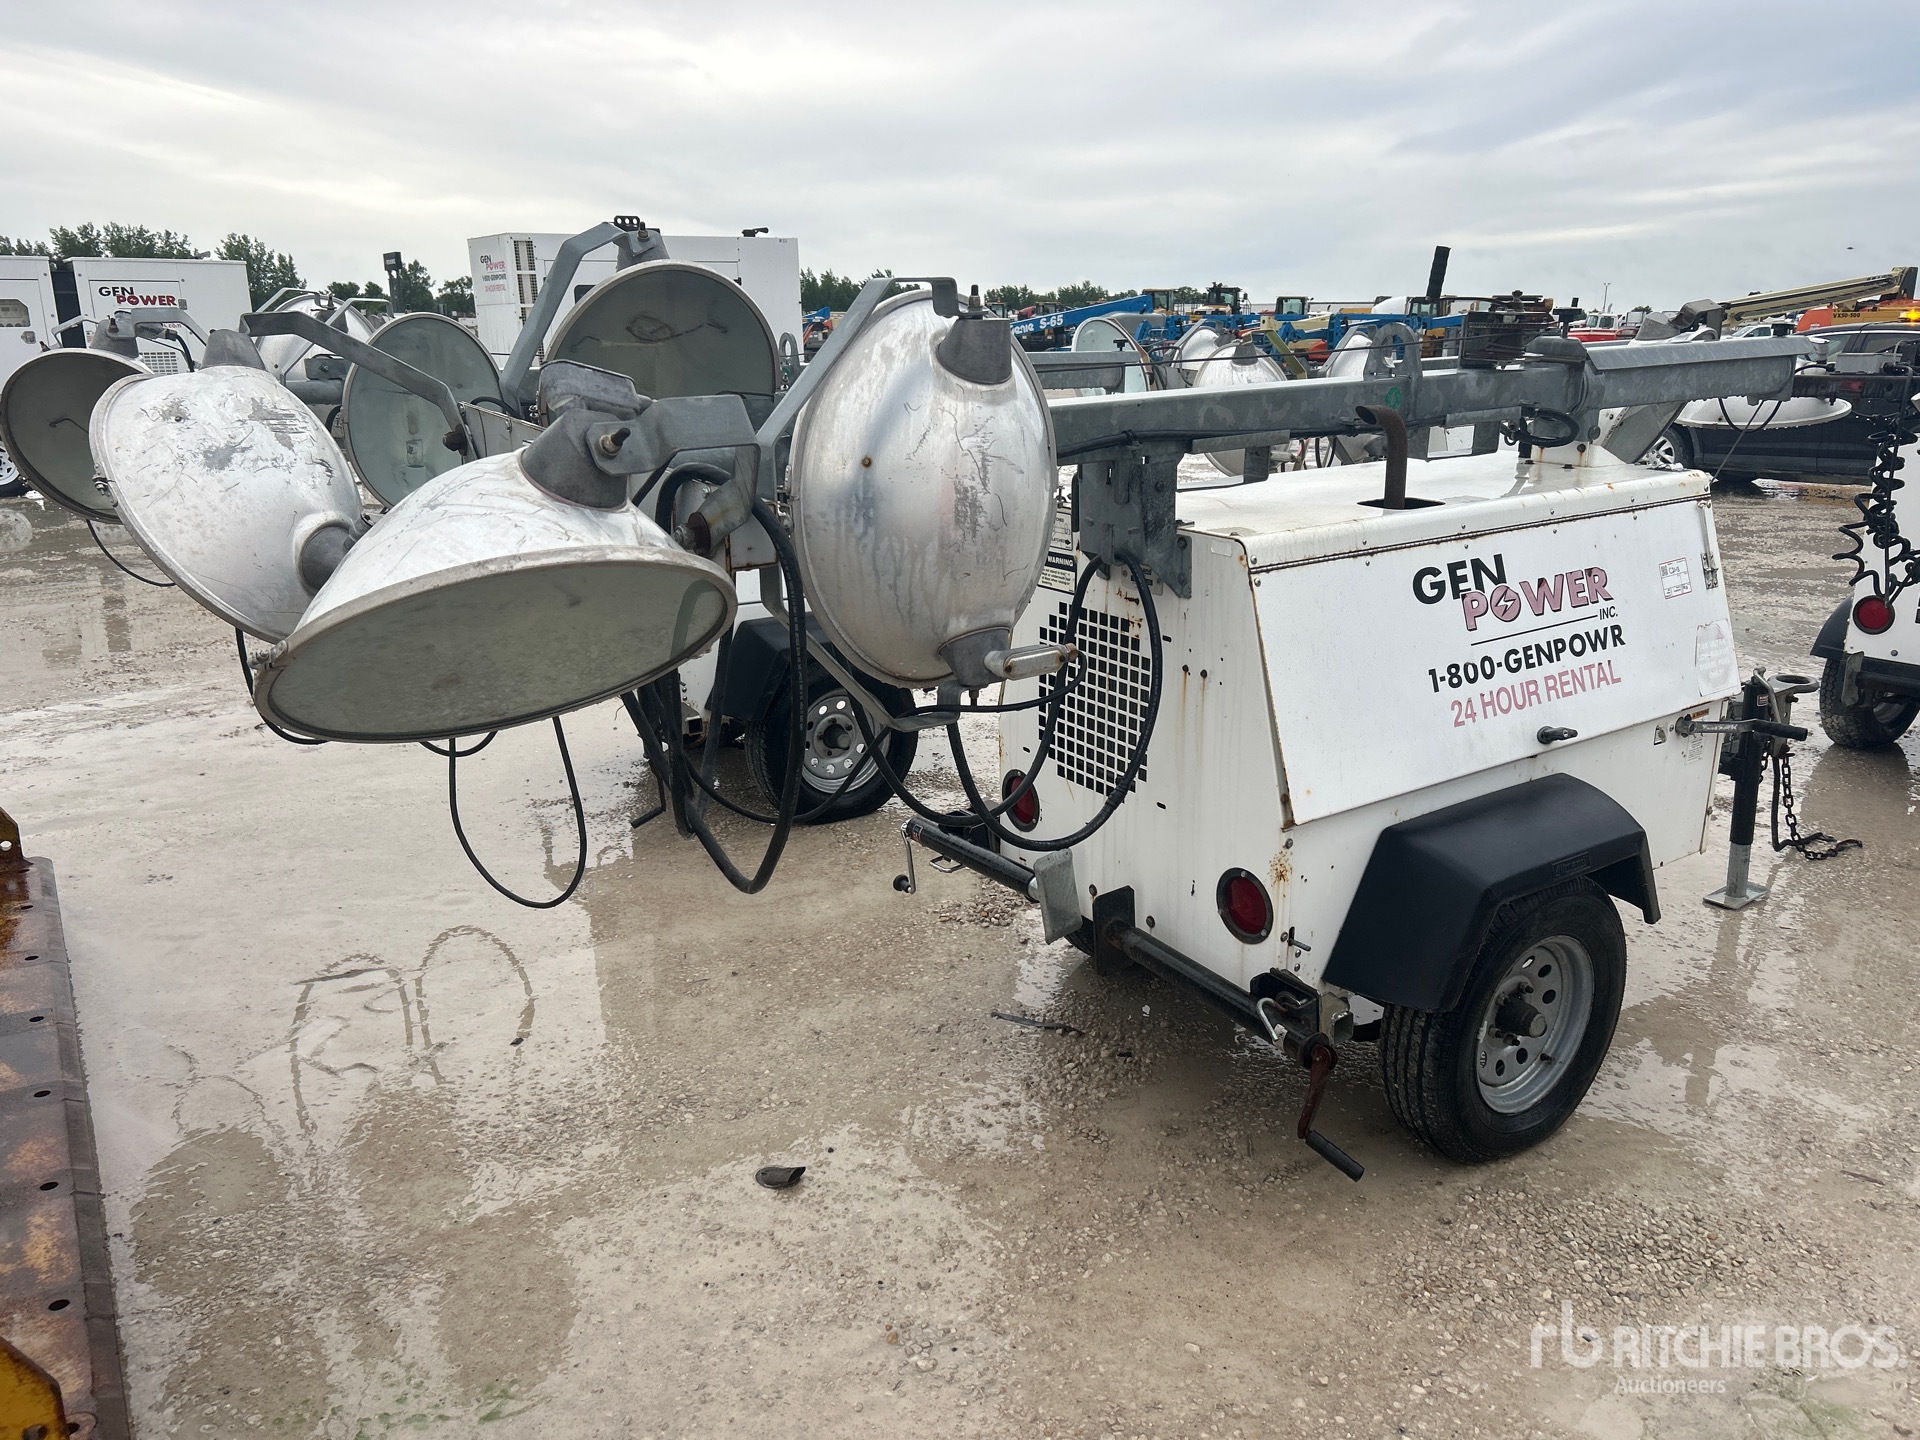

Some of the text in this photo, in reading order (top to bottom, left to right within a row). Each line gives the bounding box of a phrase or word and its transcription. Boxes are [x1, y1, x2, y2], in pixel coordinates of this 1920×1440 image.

[480, 255, 491, 264] GEN
[98, 286, 134, 297] GEN
[116, 294, 177, 307] POWER
[1040, 315, 1063, 329] S-65
[1047, 555, 1074, 567] WARNING
[1412, 553, 1507, 605] GEN
[1461, 566, 1614, 631] POWER
[1599, 606, 1619, 621] INC.
[1428, 624, 1626, 692] 1-800-GENPOWR
[1450, 659, 1622, 728] 24 HOUR RENTAL
